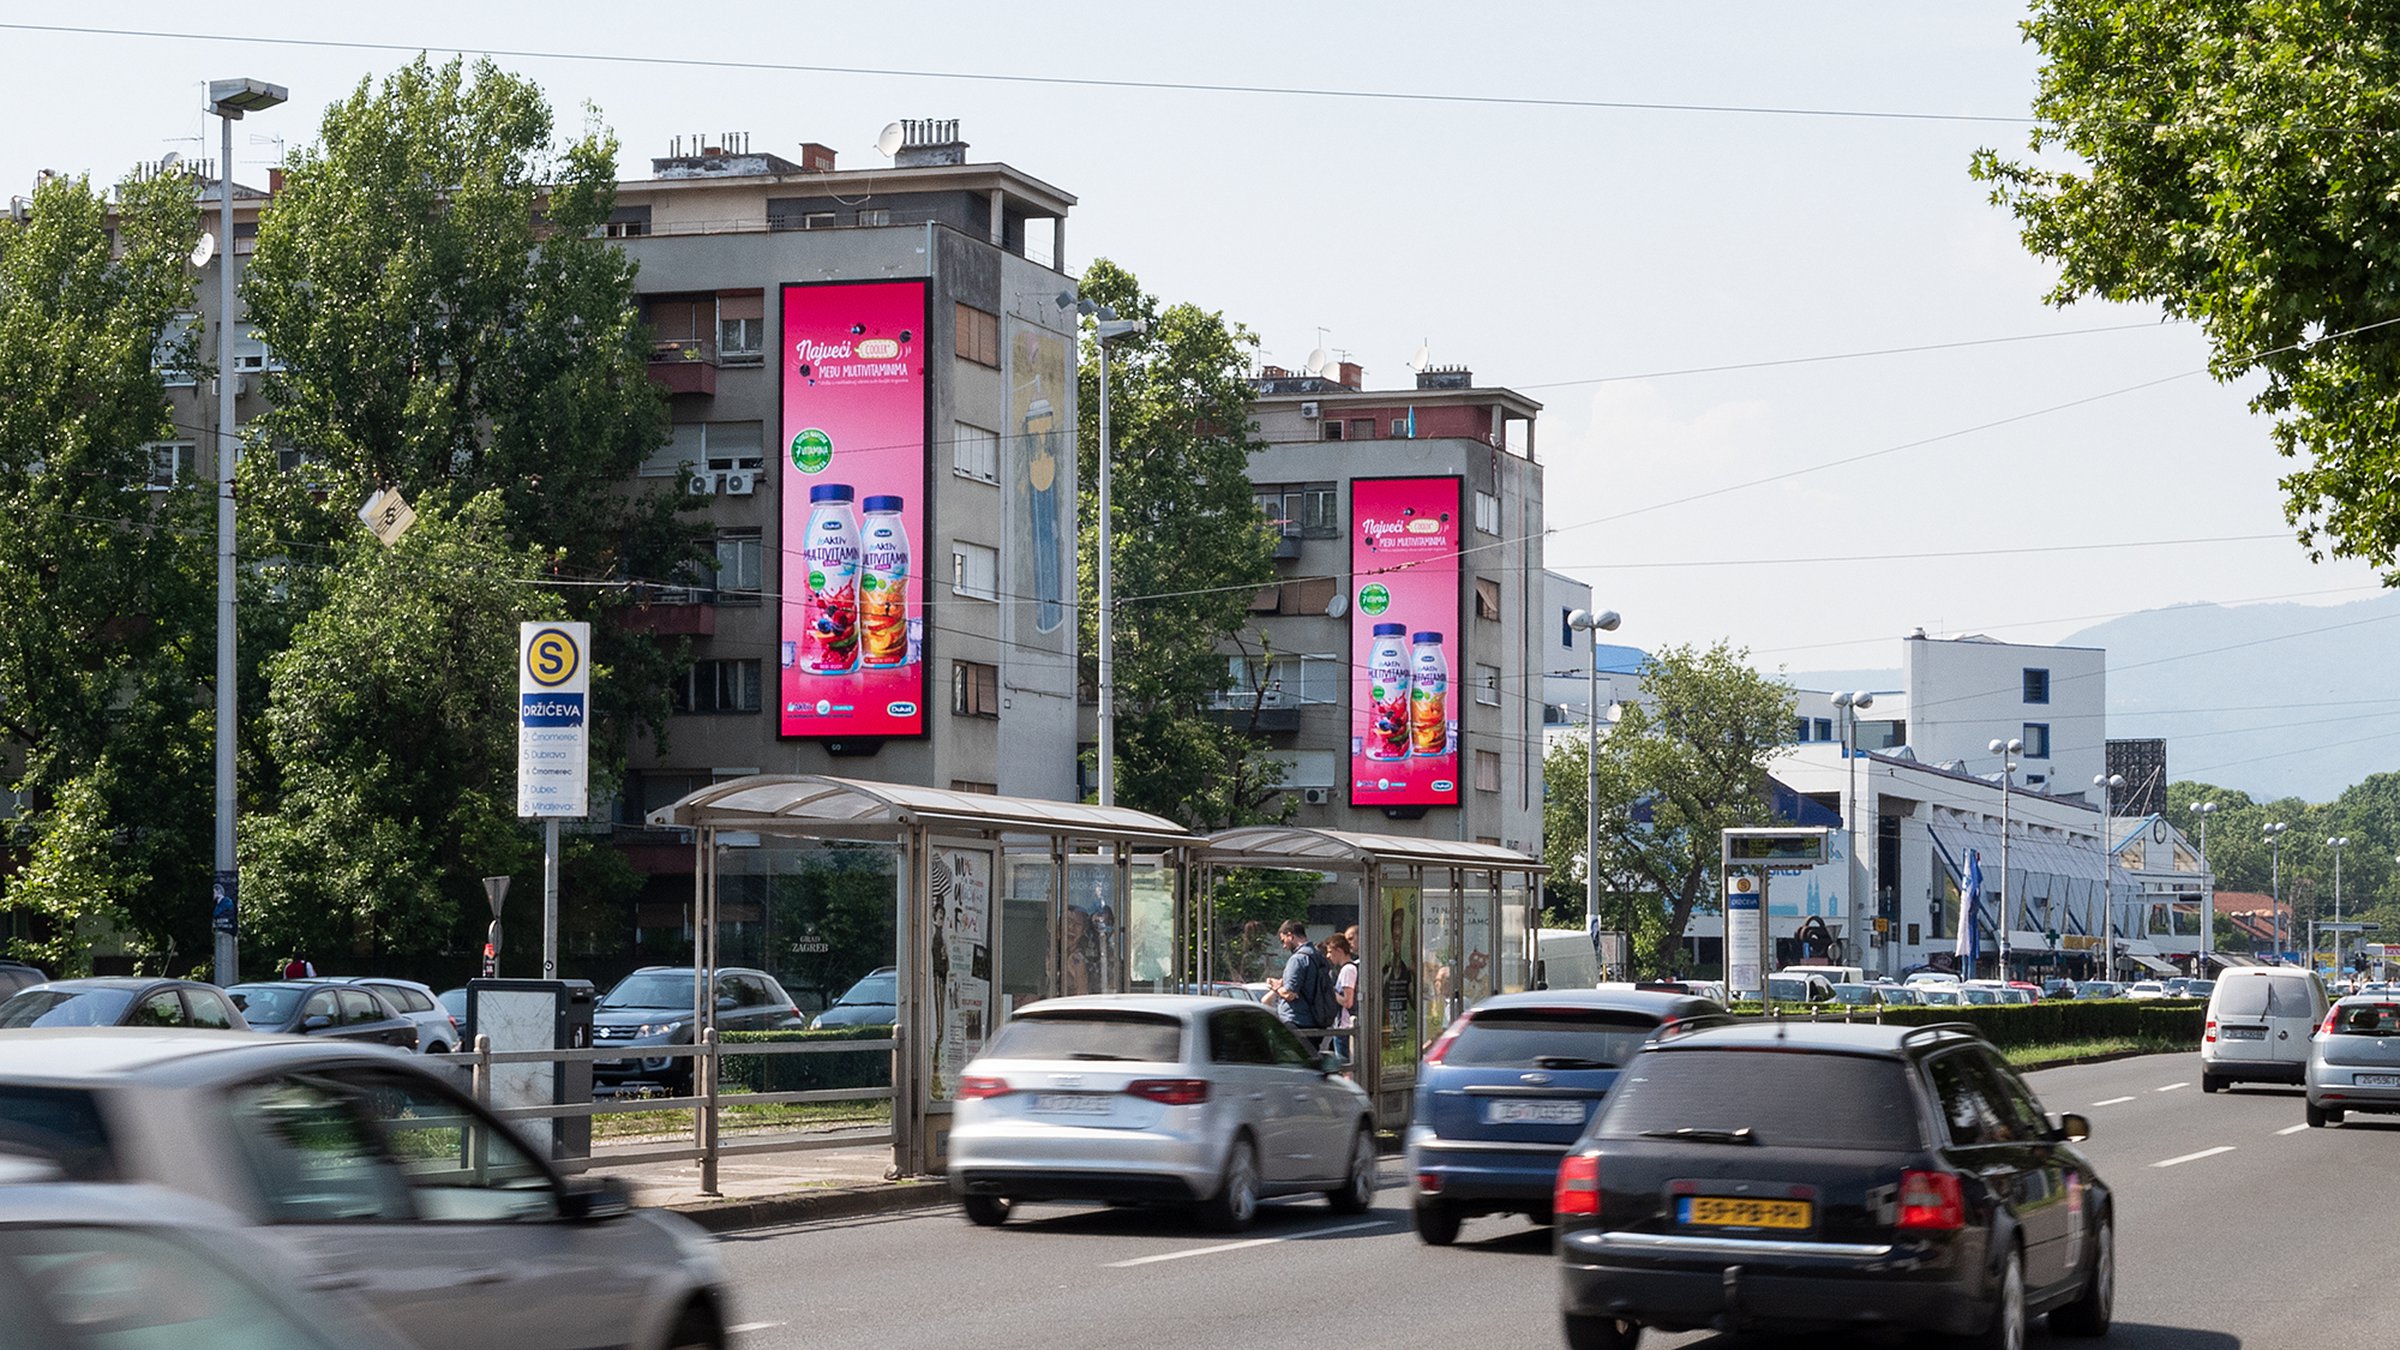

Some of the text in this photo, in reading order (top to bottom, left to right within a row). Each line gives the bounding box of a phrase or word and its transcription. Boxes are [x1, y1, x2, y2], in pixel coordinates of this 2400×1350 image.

[796, 339, 852, 367] Najveći
[843, 363, 909, 378] MULTIVITAMINIMA
[539, 641, 563, 675] S
[523, 701, 581, 717] DRŽIĆEVA
[531, 750, 566, 759] Dubrava
[792, 943, 829, 953] ZAGREB
